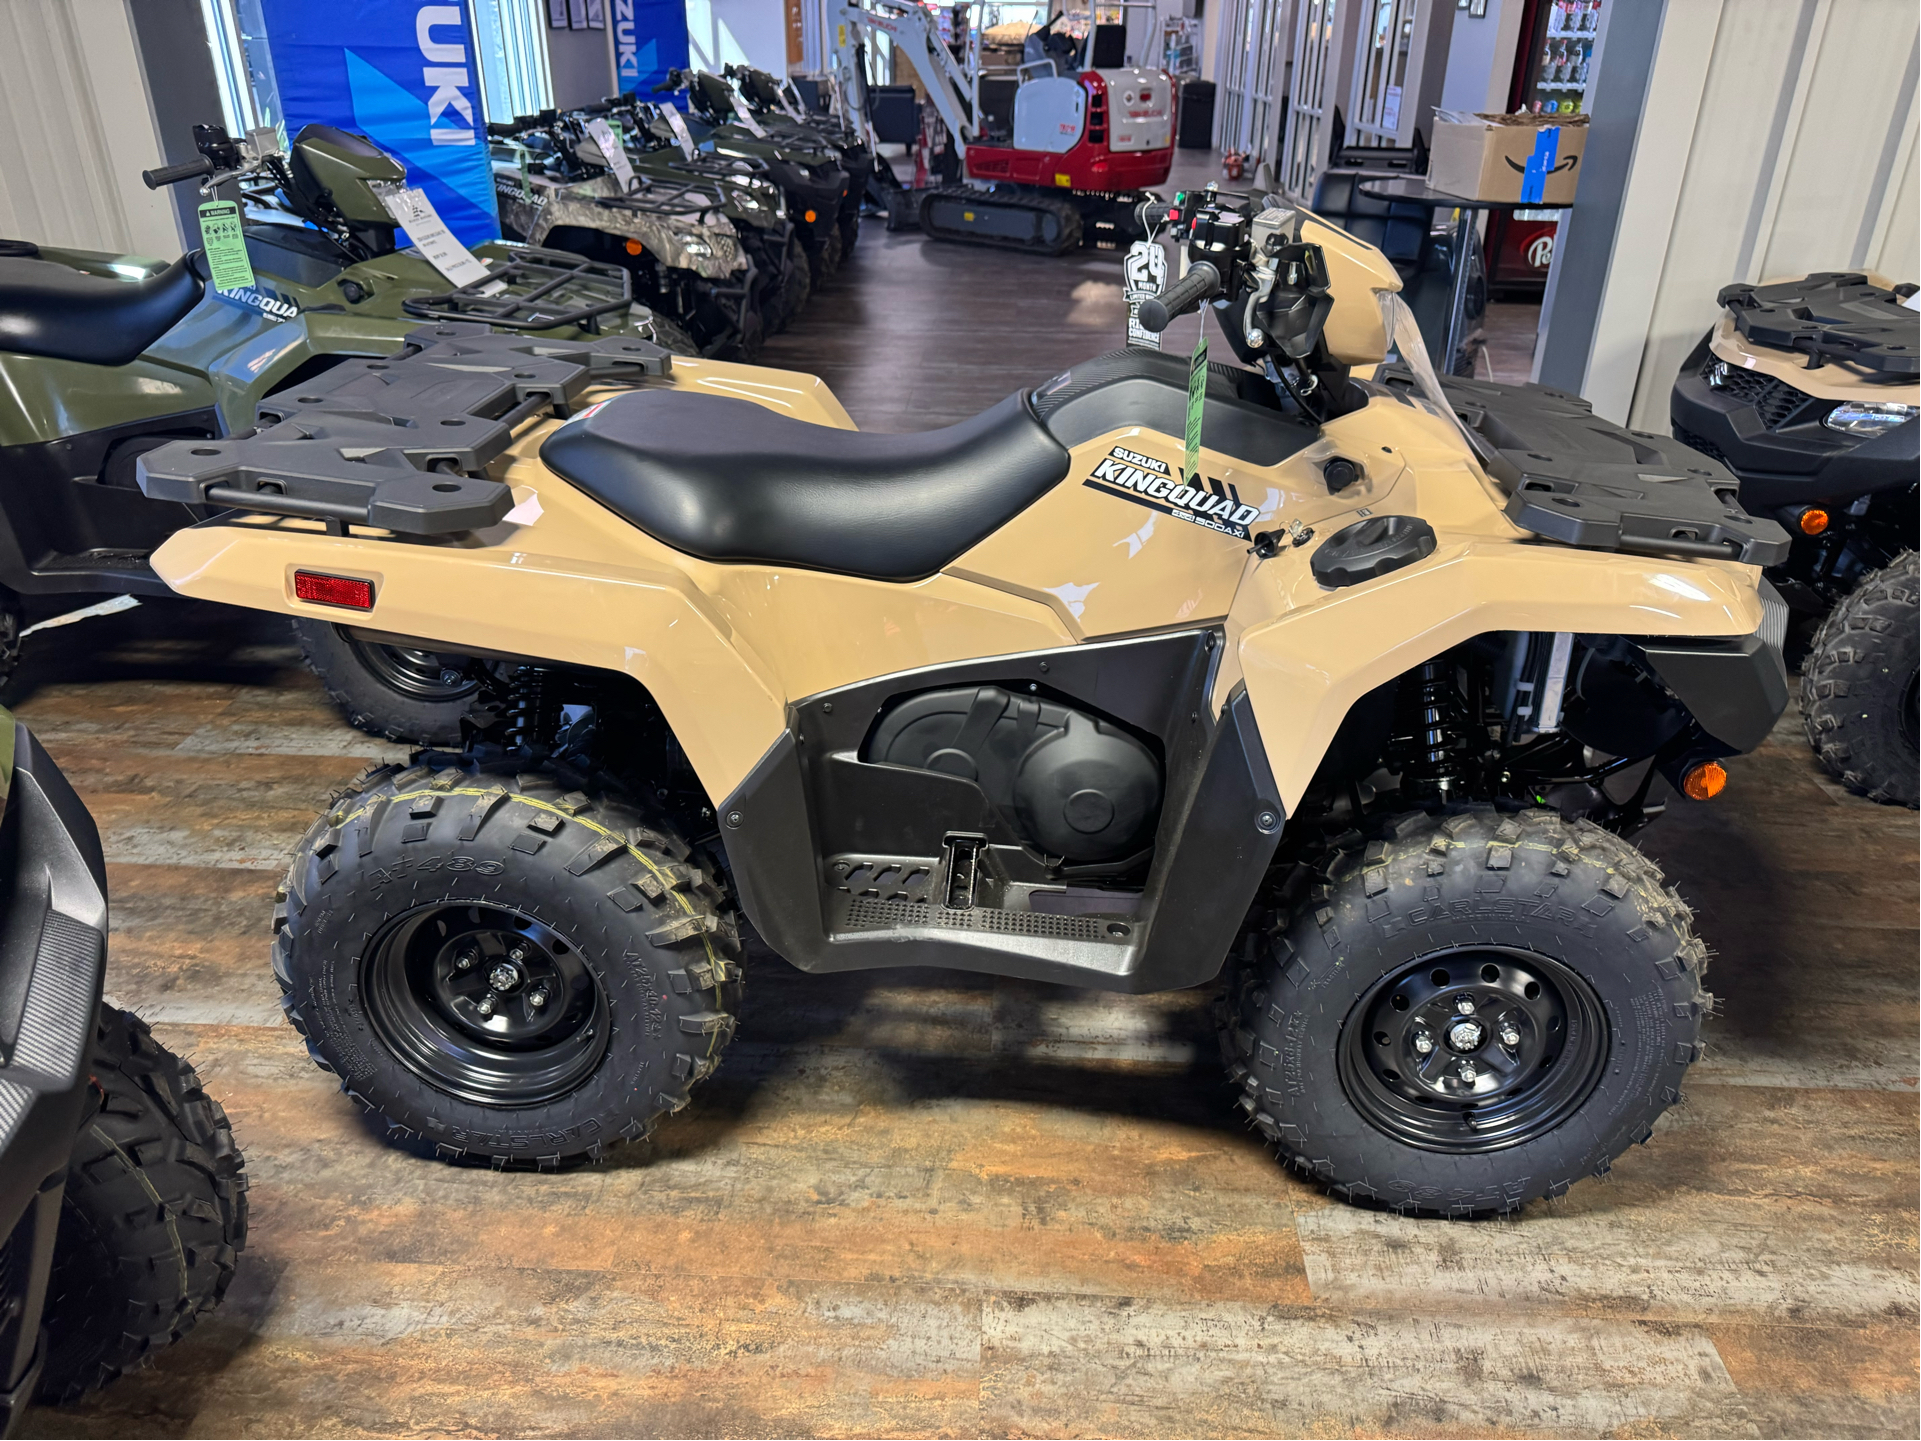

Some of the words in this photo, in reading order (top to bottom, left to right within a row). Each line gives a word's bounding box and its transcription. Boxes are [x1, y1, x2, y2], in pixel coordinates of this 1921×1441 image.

[416, 0, 476, 146] UKI
[1129, 242, 1164, 285] 24
[216, 287, 299, 318] KINGQUA
[1112, 446, 1167, 473] SUZUKI
[1094, 457, 1261, 526] KINGQUAD
[1407, 897, 1576, 927] CARLSTAR
[452, 1117, 603, 1149] CARLSTAR
